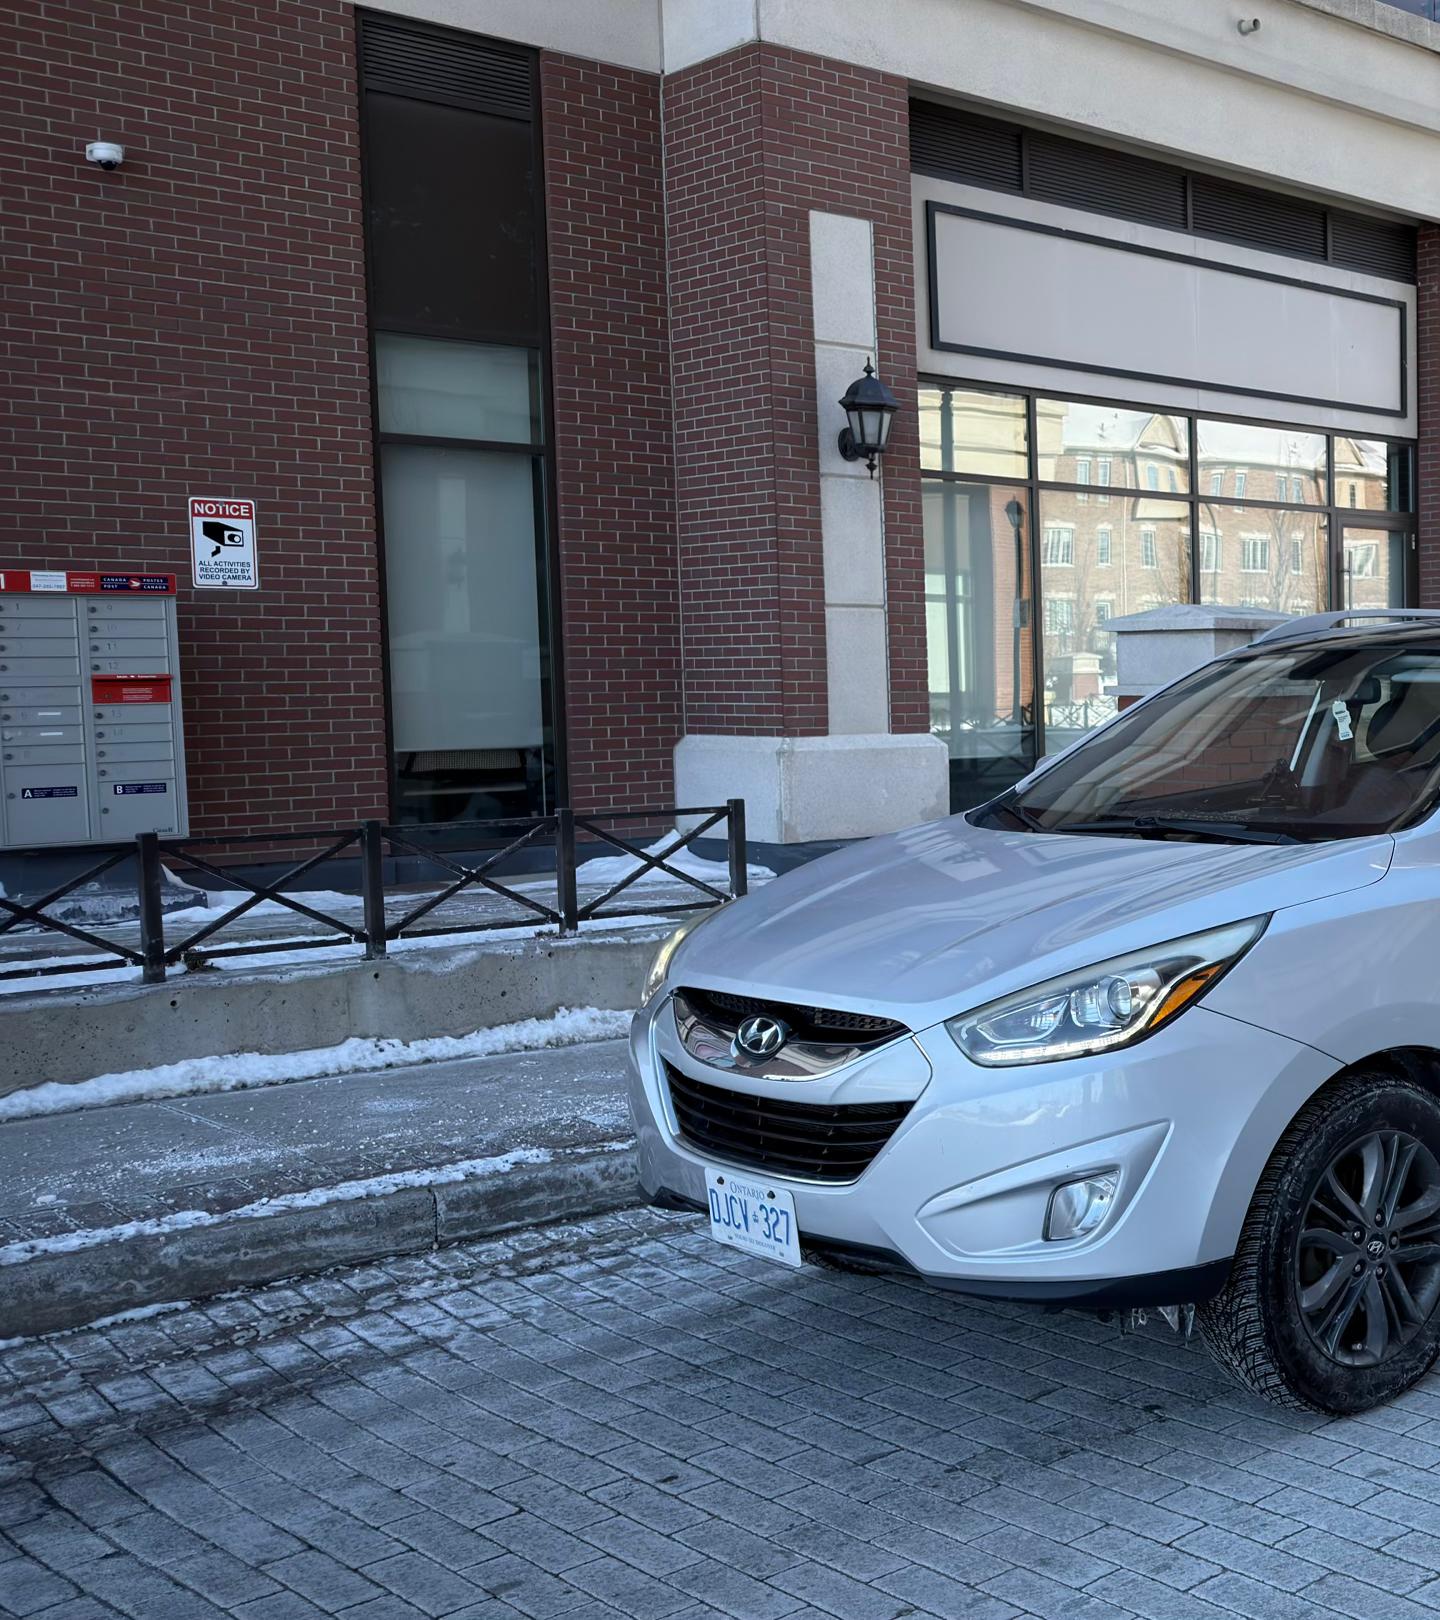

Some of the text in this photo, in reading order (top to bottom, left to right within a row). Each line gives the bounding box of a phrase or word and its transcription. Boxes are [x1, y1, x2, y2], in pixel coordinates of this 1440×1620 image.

[194, 503, 250, 516] NOTICE
[24, 789, 32, 799] A
[116, 785, 123, 794] B
[730, 1181, 764, 1200] ONTARIO
